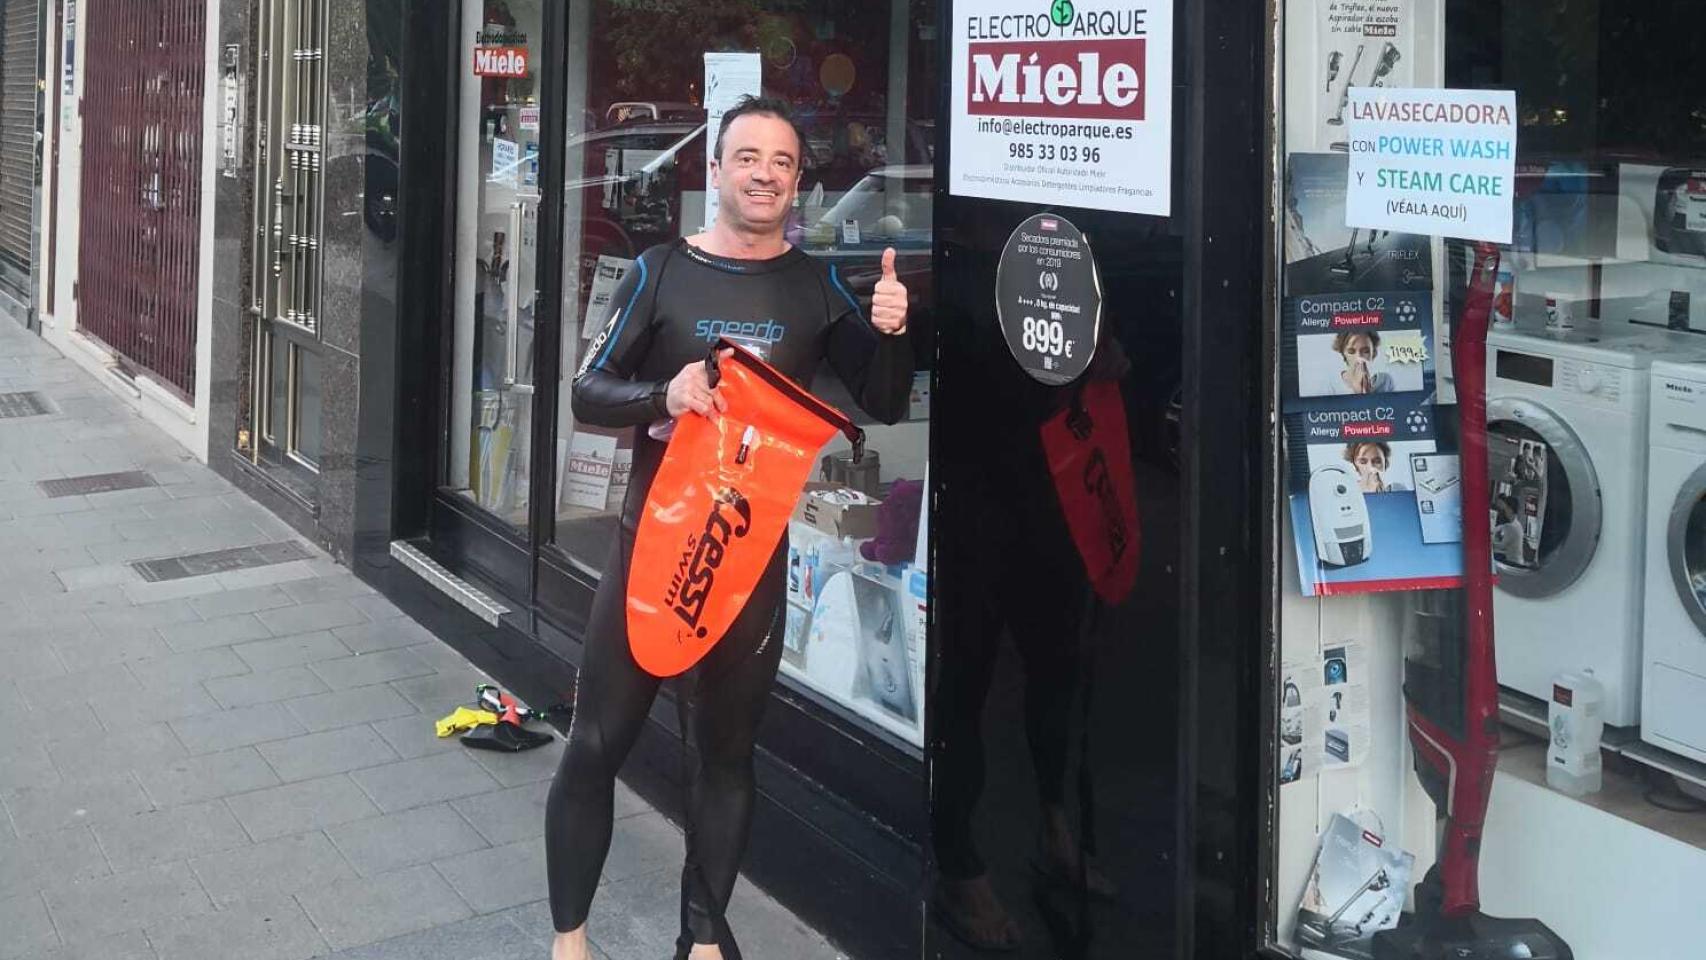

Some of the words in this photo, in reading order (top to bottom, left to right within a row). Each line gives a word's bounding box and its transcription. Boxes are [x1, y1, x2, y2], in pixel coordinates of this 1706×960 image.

[1328, 14, 1363, 24] Aspirador
[475, 49, 525, 74] Miele
[971, 52, 1140, 107] Miele
[1352, 101, 1511, 125] LAVASECADORA
[978, 118, 1133, 140] info@electroparque.es
[1009, 142, 1034, 159] 985
[1038, 144, 1055, 160] 33
[1060, 145, 1078, 162] 03
[1082, 147, 1100, 163] 96
[1352, 140, 1376, 153] CON
[1378, 136, 1444, 157] POWER
[1449, 139, 1511, 160] WASH
[1356, 171, 1365, 186] Y
[1376, 168, 1443, 191] STEAM
[1449, 173, 1503, 196] CARE
[1386, 200, 1428, 216] (VÉALA
[1431, 203, 1467, 222] AQUÍ)
[1386, 250, 1419, 260] TRIFLEX
[1300, 299, 1362, 316] Compact
[1366, 297, 1385, 311] C2
[695, 319, 785, 342] speedo
[1301, 317, 1331, 328] Allergy
[1334, 316, 1379, 326] PowerLine
[1307, 408, 1372, 424] Compact
[1375, 407, 1395, 420] C2
[1310, 427, 1340, 438] Allergy
[1344, 424, 1391, 436] PowerLine
[673, 486, 752, 639] Cressi
